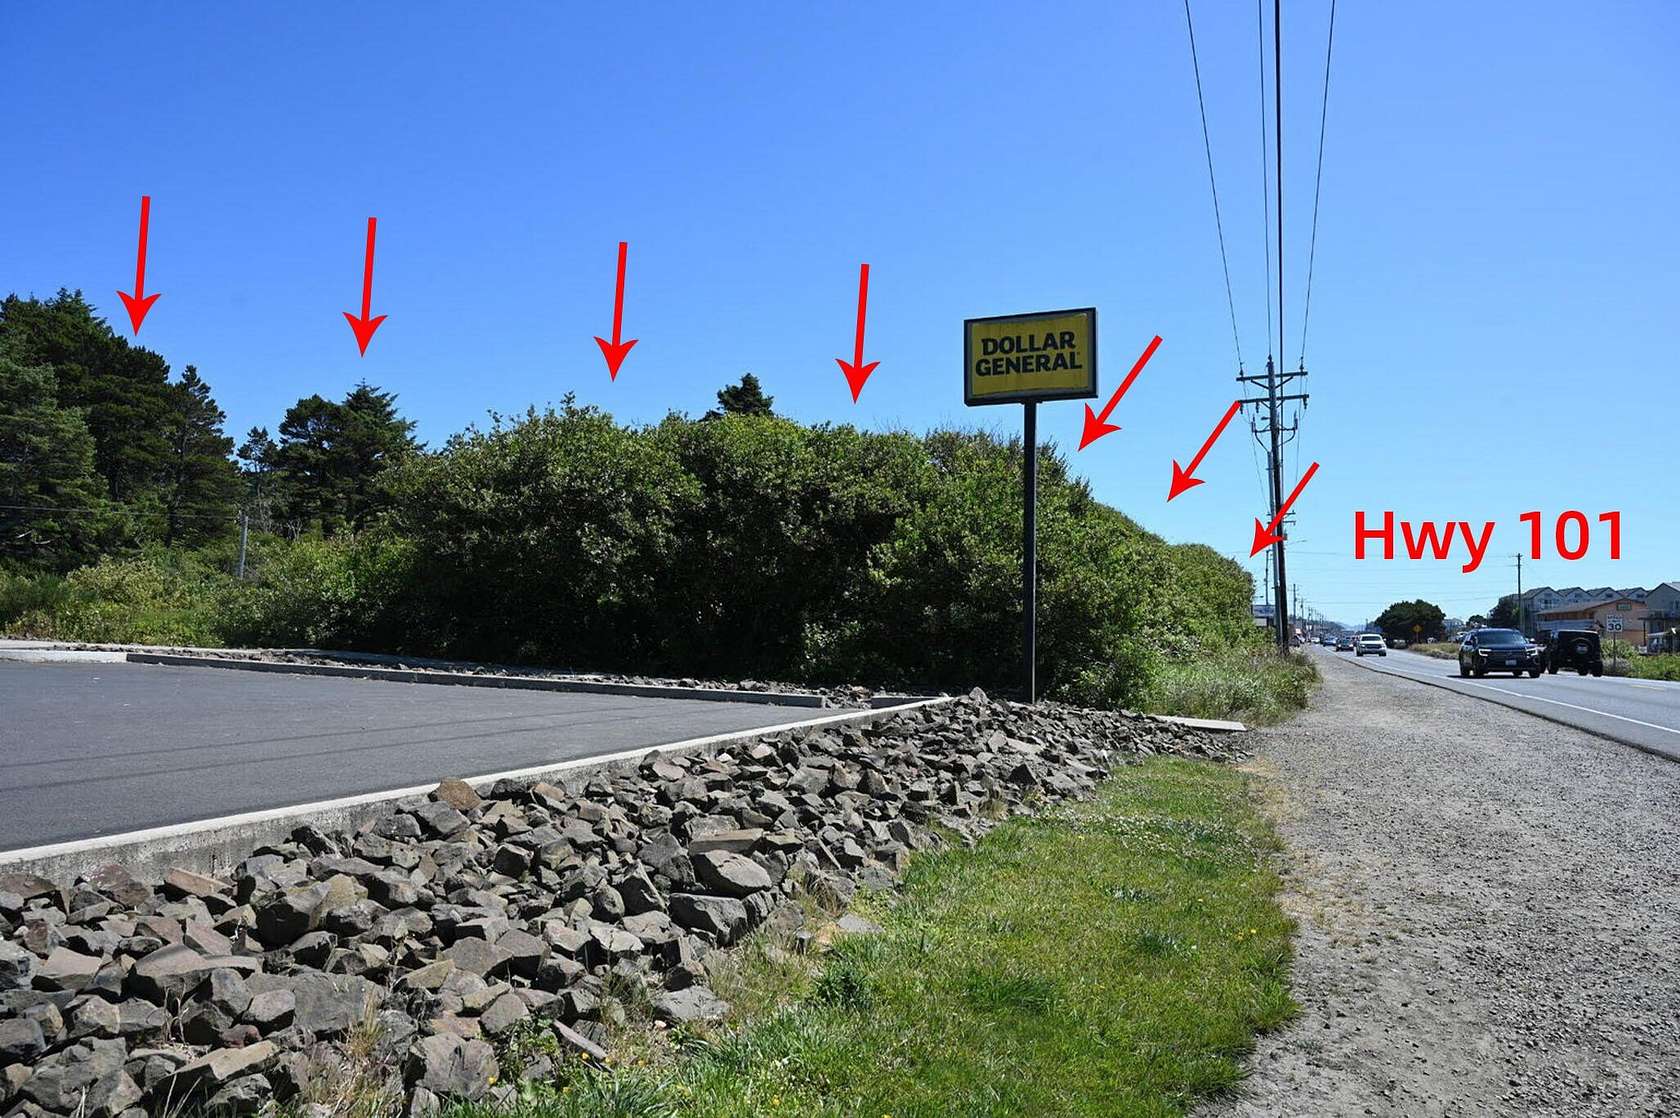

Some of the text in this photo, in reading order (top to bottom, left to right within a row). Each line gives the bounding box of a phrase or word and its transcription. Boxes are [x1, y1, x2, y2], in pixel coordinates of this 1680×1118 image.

[981, 331, 1077, 356] DOLLAR
[975, 351, 1083, 377] GENERAL
[1607, 623, 1622, 631] 30
